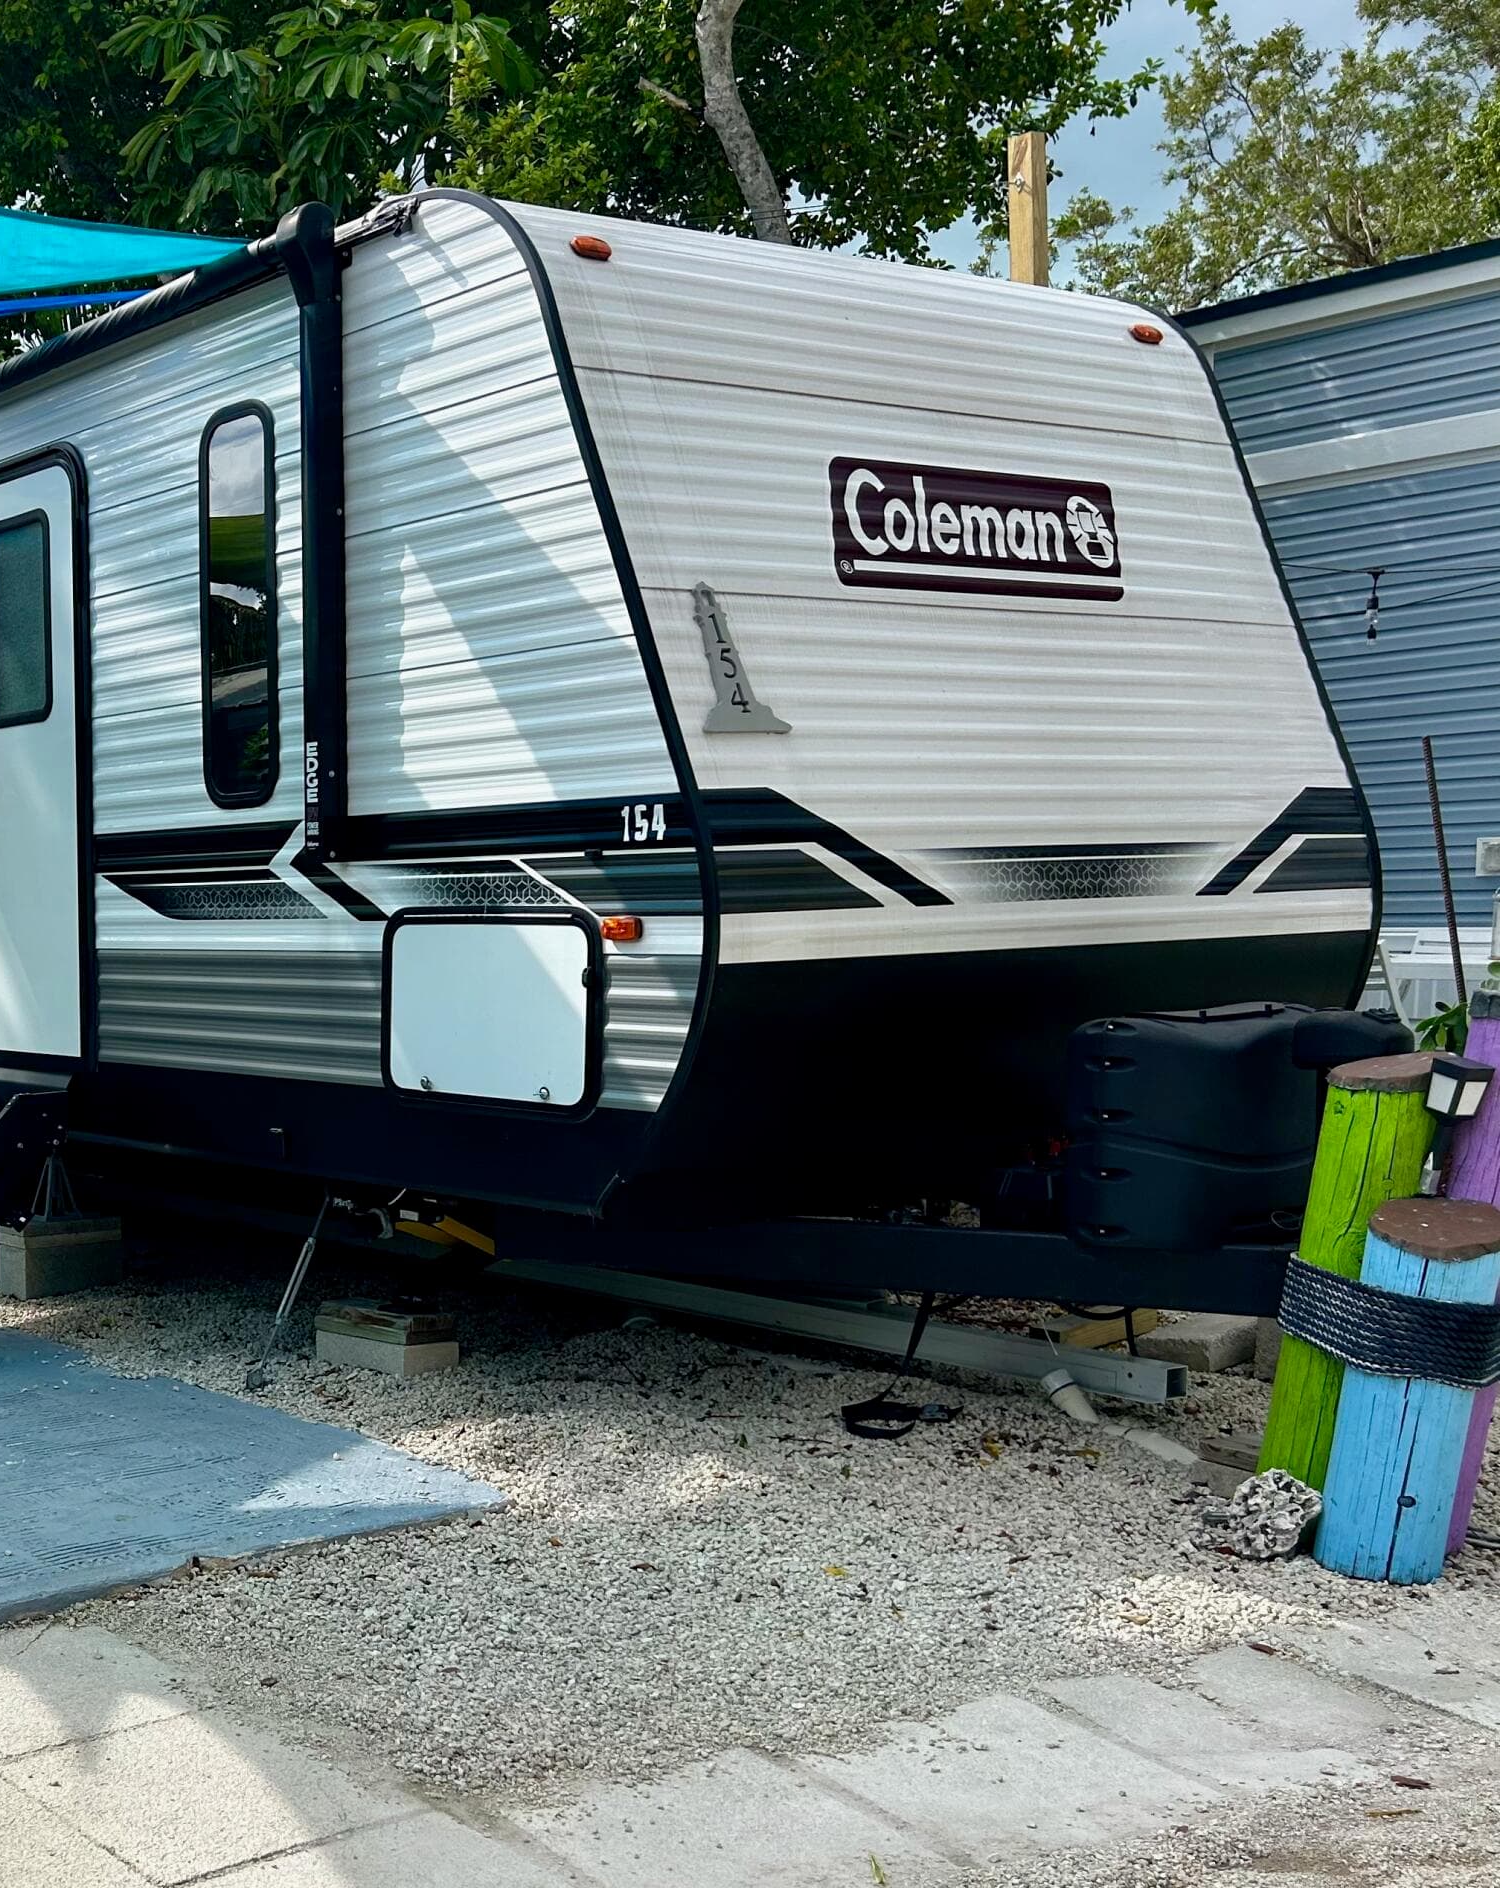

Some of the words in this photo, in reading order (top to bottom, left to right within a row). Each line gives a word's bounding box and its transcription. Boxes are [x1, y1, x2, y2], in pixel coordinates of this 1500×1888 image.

[844, 467, 1067, 563] Coleman
[707, 613, 752, 714] 154
[306, 741, 319, 803] EDGE
[621, 803, 667, 842] 154
